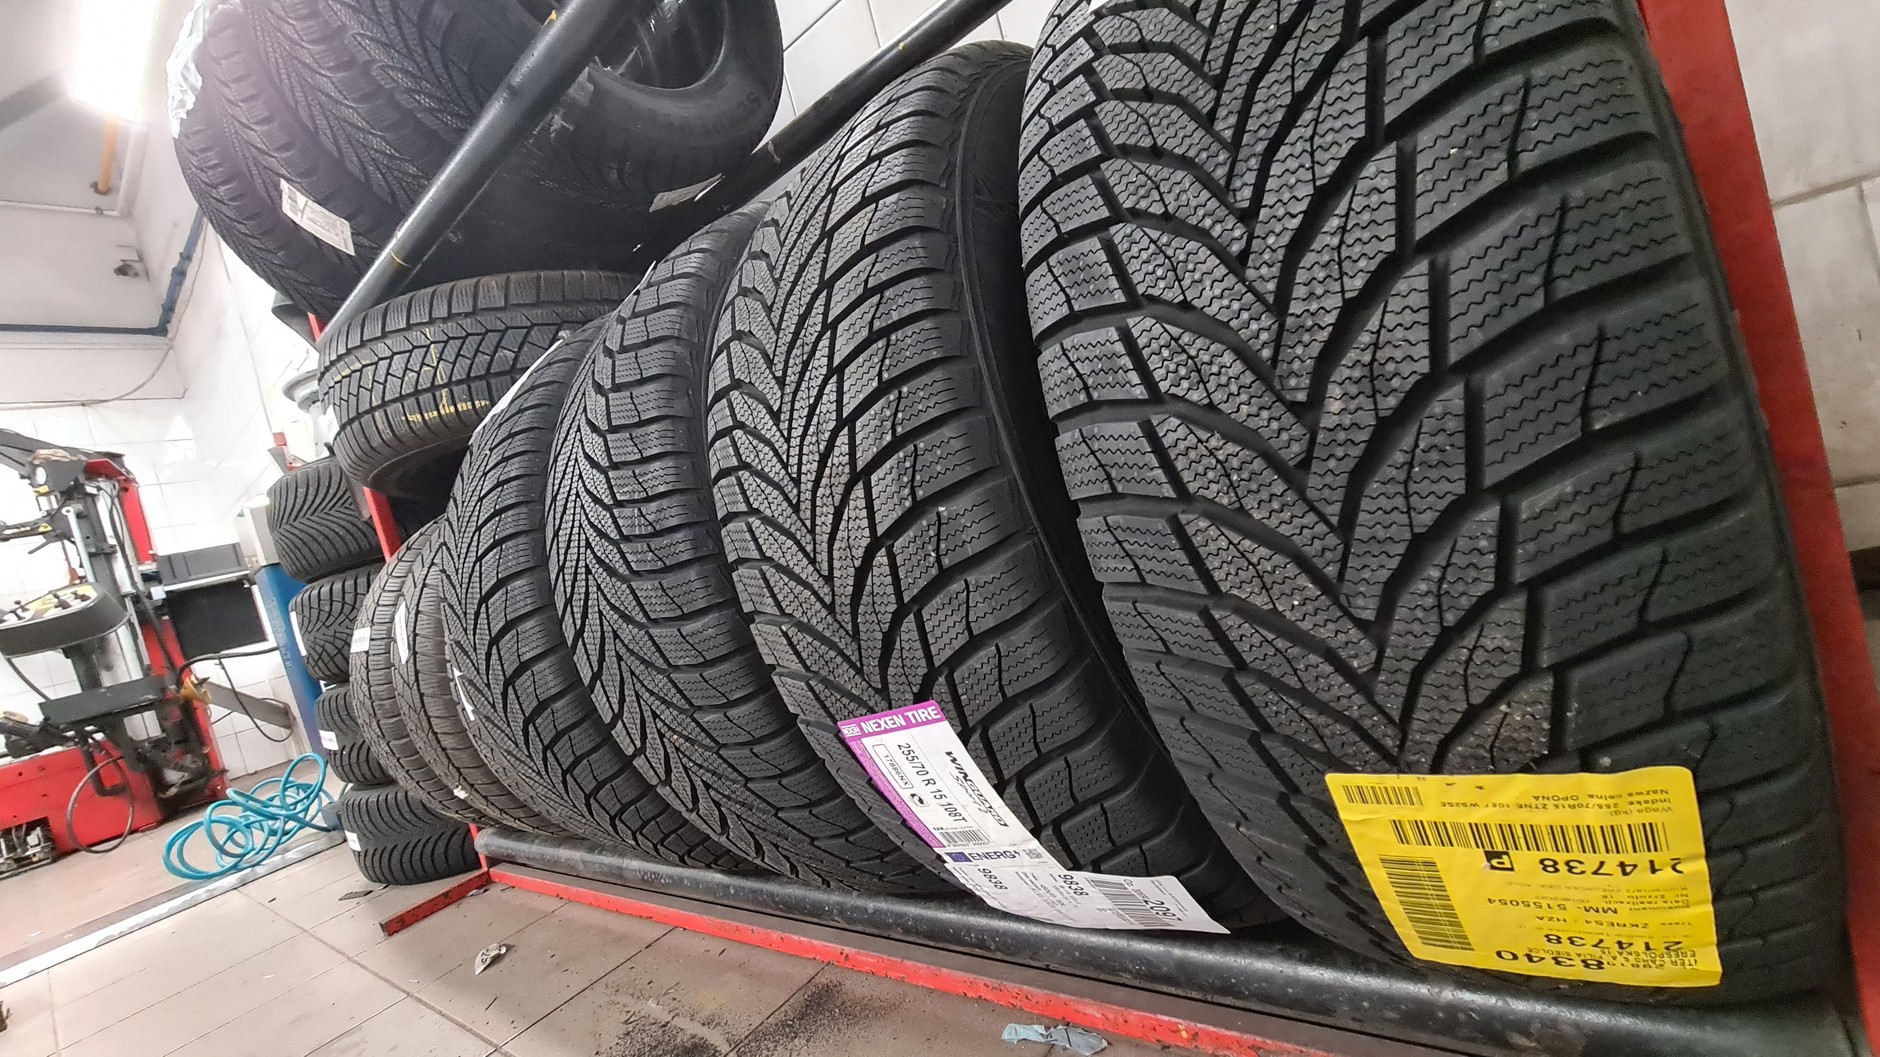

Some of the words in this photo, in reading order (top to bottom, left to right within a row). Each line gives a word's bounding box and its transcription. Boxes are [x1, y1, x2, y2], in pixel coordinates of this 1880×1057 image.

[860, 714, 907, 734] NEXEN
[904, 706, 942, 724] TIRE
[883, 754, 910, 786] 17886NX
[897, 742, 929, 776] 255/70
[921, 778, 937, 787] R
[930, 787, 948, 801] 15
[940, 802, 968, 823] 108T
[945, 751, 1011, 828] WINGUARD
[968, 850, 1014, 861] ENERG
[1538, 857, 1685, 876] 214738
[978, 867, 1009, 890] 9838
[1058, 873, 1090, 897] 9838
[1487, 897, 1567, 911] 5155054
[1543, 933, 1683, 951] 214738
[1495, 949, 1606, 970] 8340
